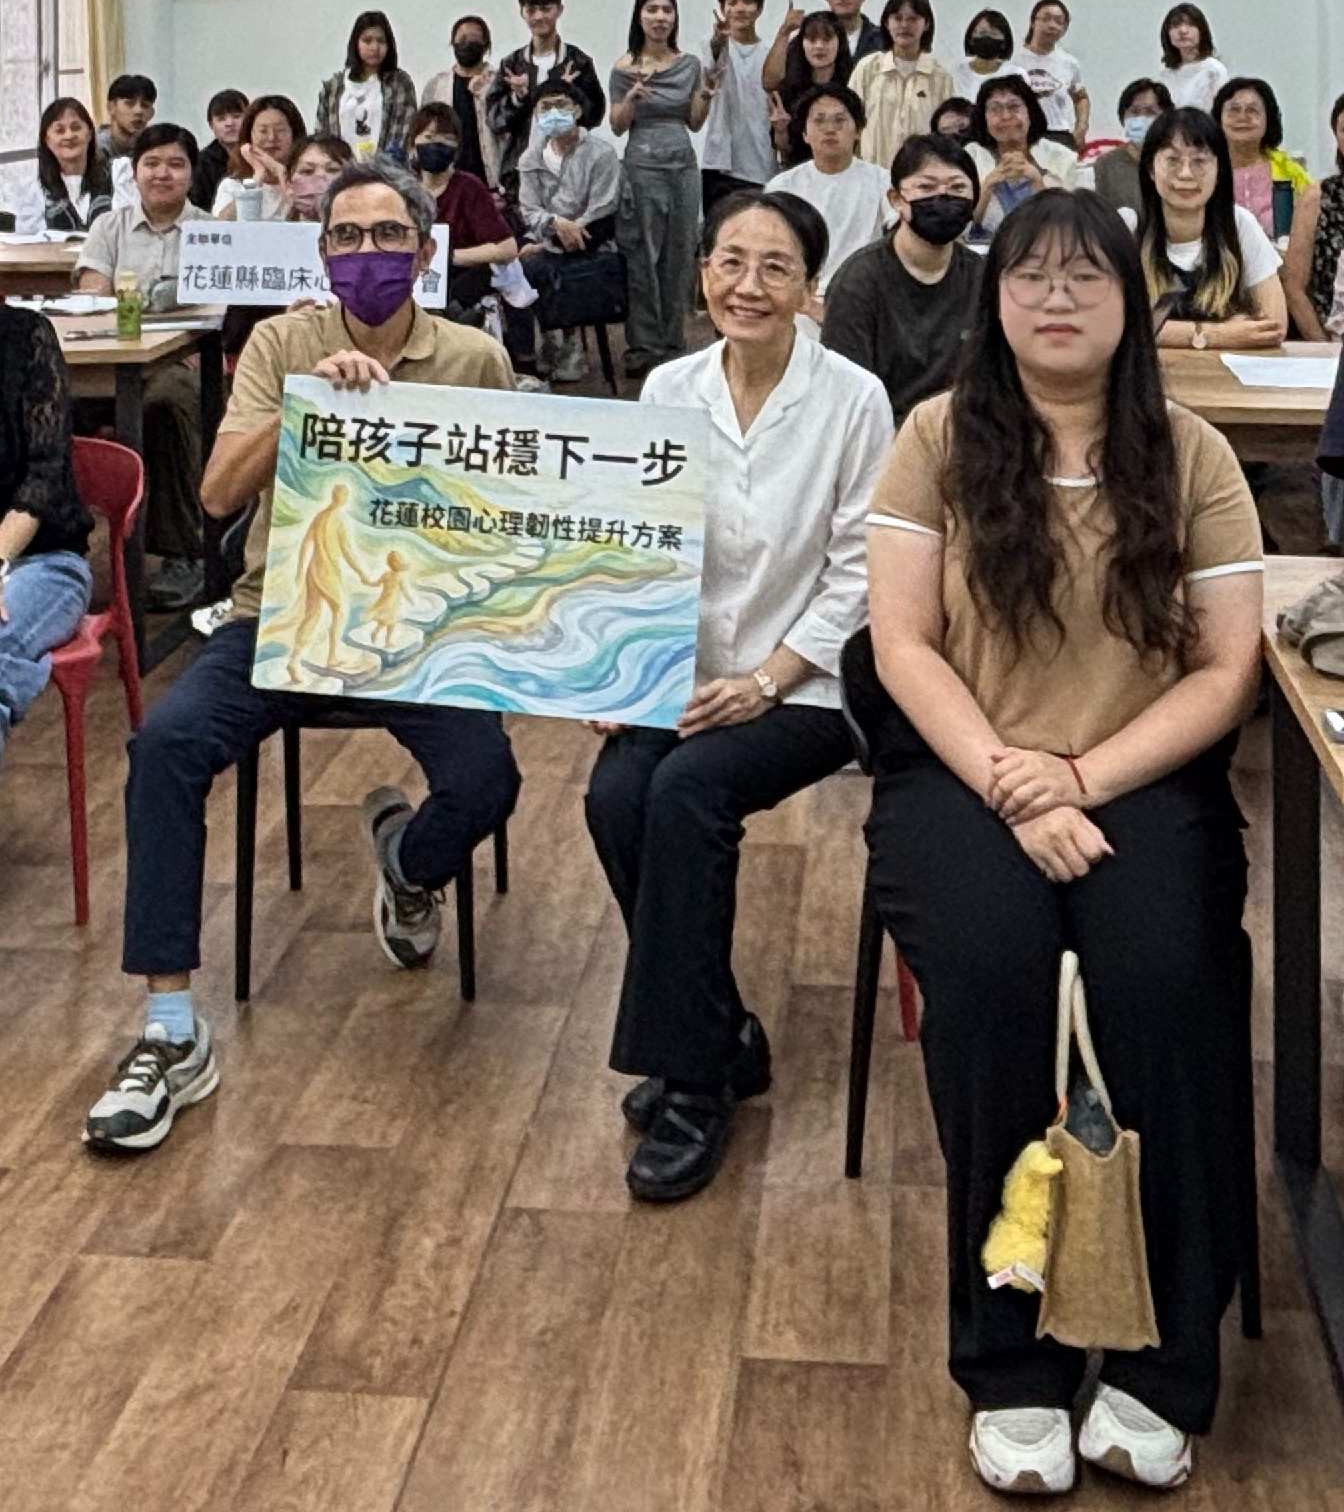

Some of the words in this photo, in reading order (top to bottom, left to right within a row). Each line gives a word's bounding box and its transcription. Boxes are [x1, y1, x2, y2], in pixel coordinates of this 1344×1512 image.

[299, 412, 689, 487] 陪孩子站穩下一步
[368, 498, 684, 551] 花蓮校園心理韌性提升方案
